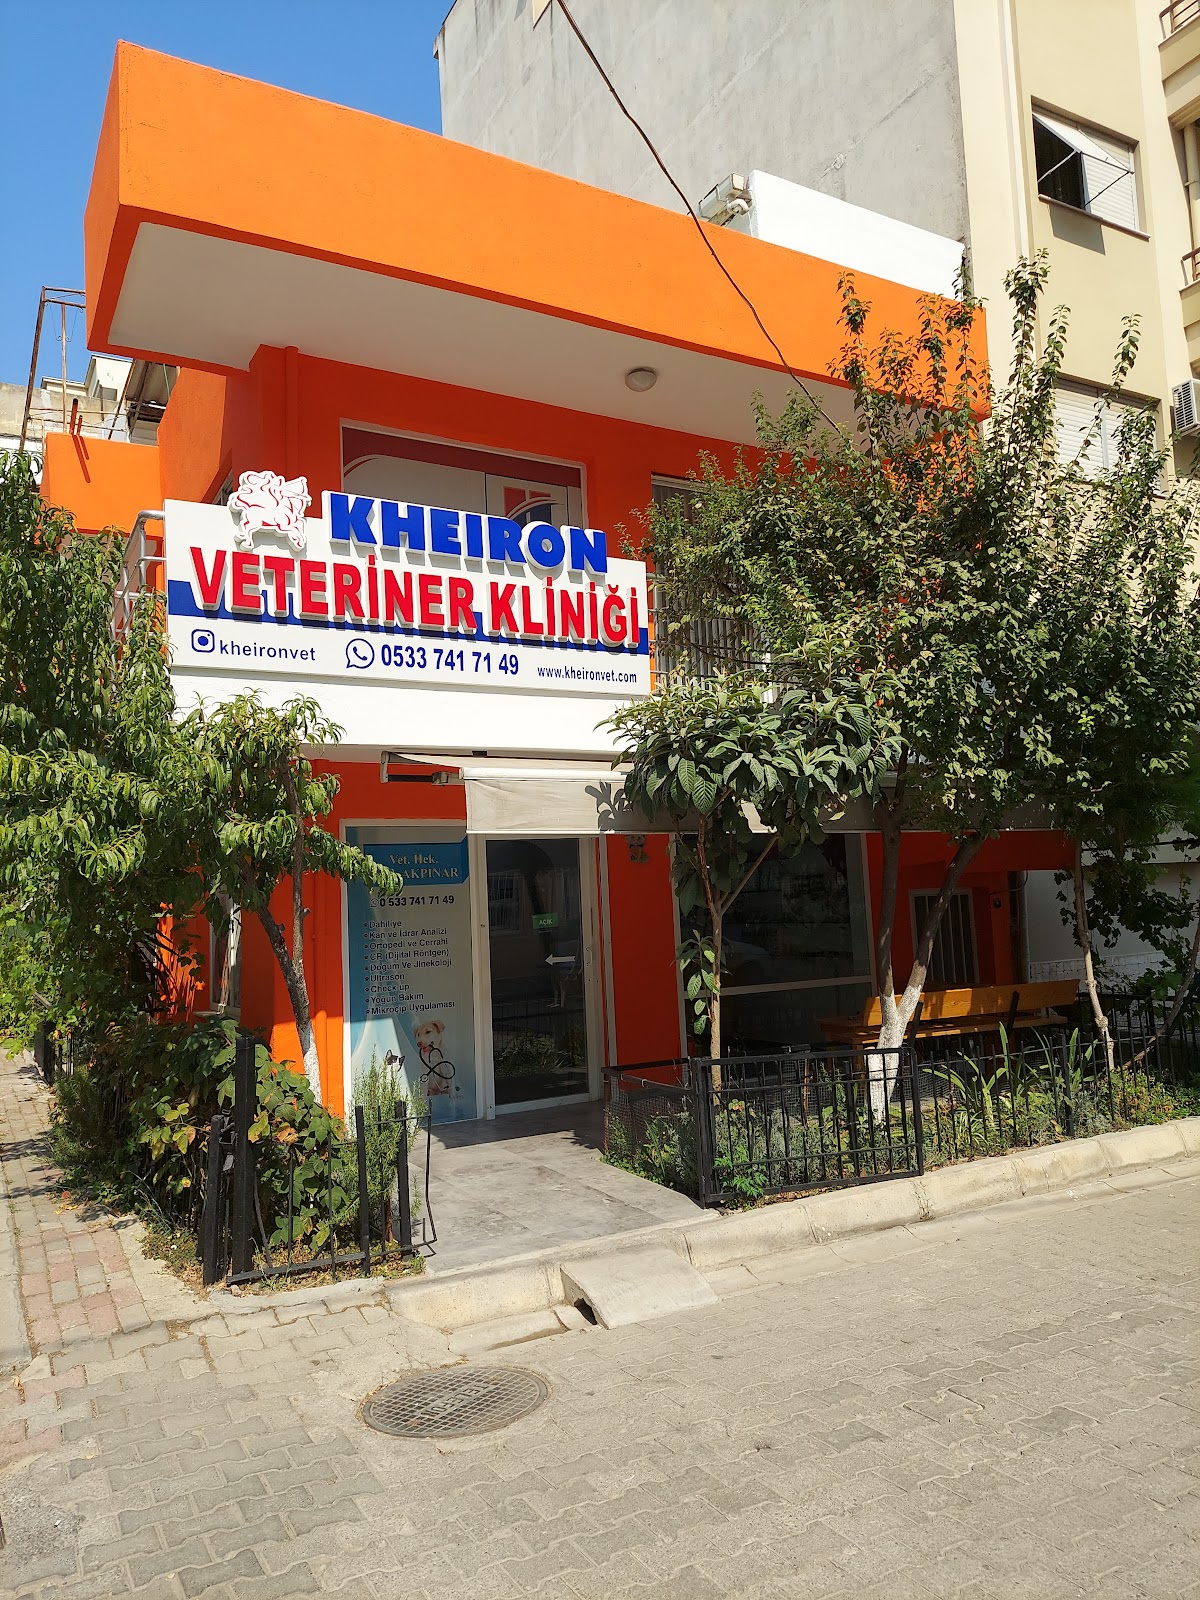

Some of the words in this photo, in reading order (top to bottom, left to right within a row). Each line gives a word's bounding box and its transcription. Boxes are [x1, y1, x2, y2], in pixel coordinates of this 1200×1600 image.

[330, 493, 607, 573] KHEIRON
[190, 547, 476, 629] VETERİNER
[489, 576, 639, 644] KLİNİĞİ
[220, 639, 316, 661] kheironvet
[381, 644, 427, 669] 0533
[433, 648, 464, 672] 741
[472, 651, 492, 673] 71
[499, 653, 519, 675] 49
[537, 665, 637, 683] www.kheironvet.com
[390, 854, 410, 865] Vet.
[414, 853, 438, 864] Hek.
[403, 867, 459, 879] AKPINAR
[380, 898, 386, 907] 0
[388, 896, 407, 907] 533
[409, 896, 425, 906] 741
[429, 895, 439, 905] 71
[443, 894, 455, 904] 49
[369, 920, 402, 929] Dahiliye
[369, 931, 385, 939] Kan
[421, 927, 447, 936] Analizi
[369, 940, 405, 950] Ortopedi
[420, 938, 448, 947] Cerrahi
[402, 961, 412, 969] Ve
[370, 973, 405, 982] Ultrason
[409, 1001, 455, 1012] Uygulaması
